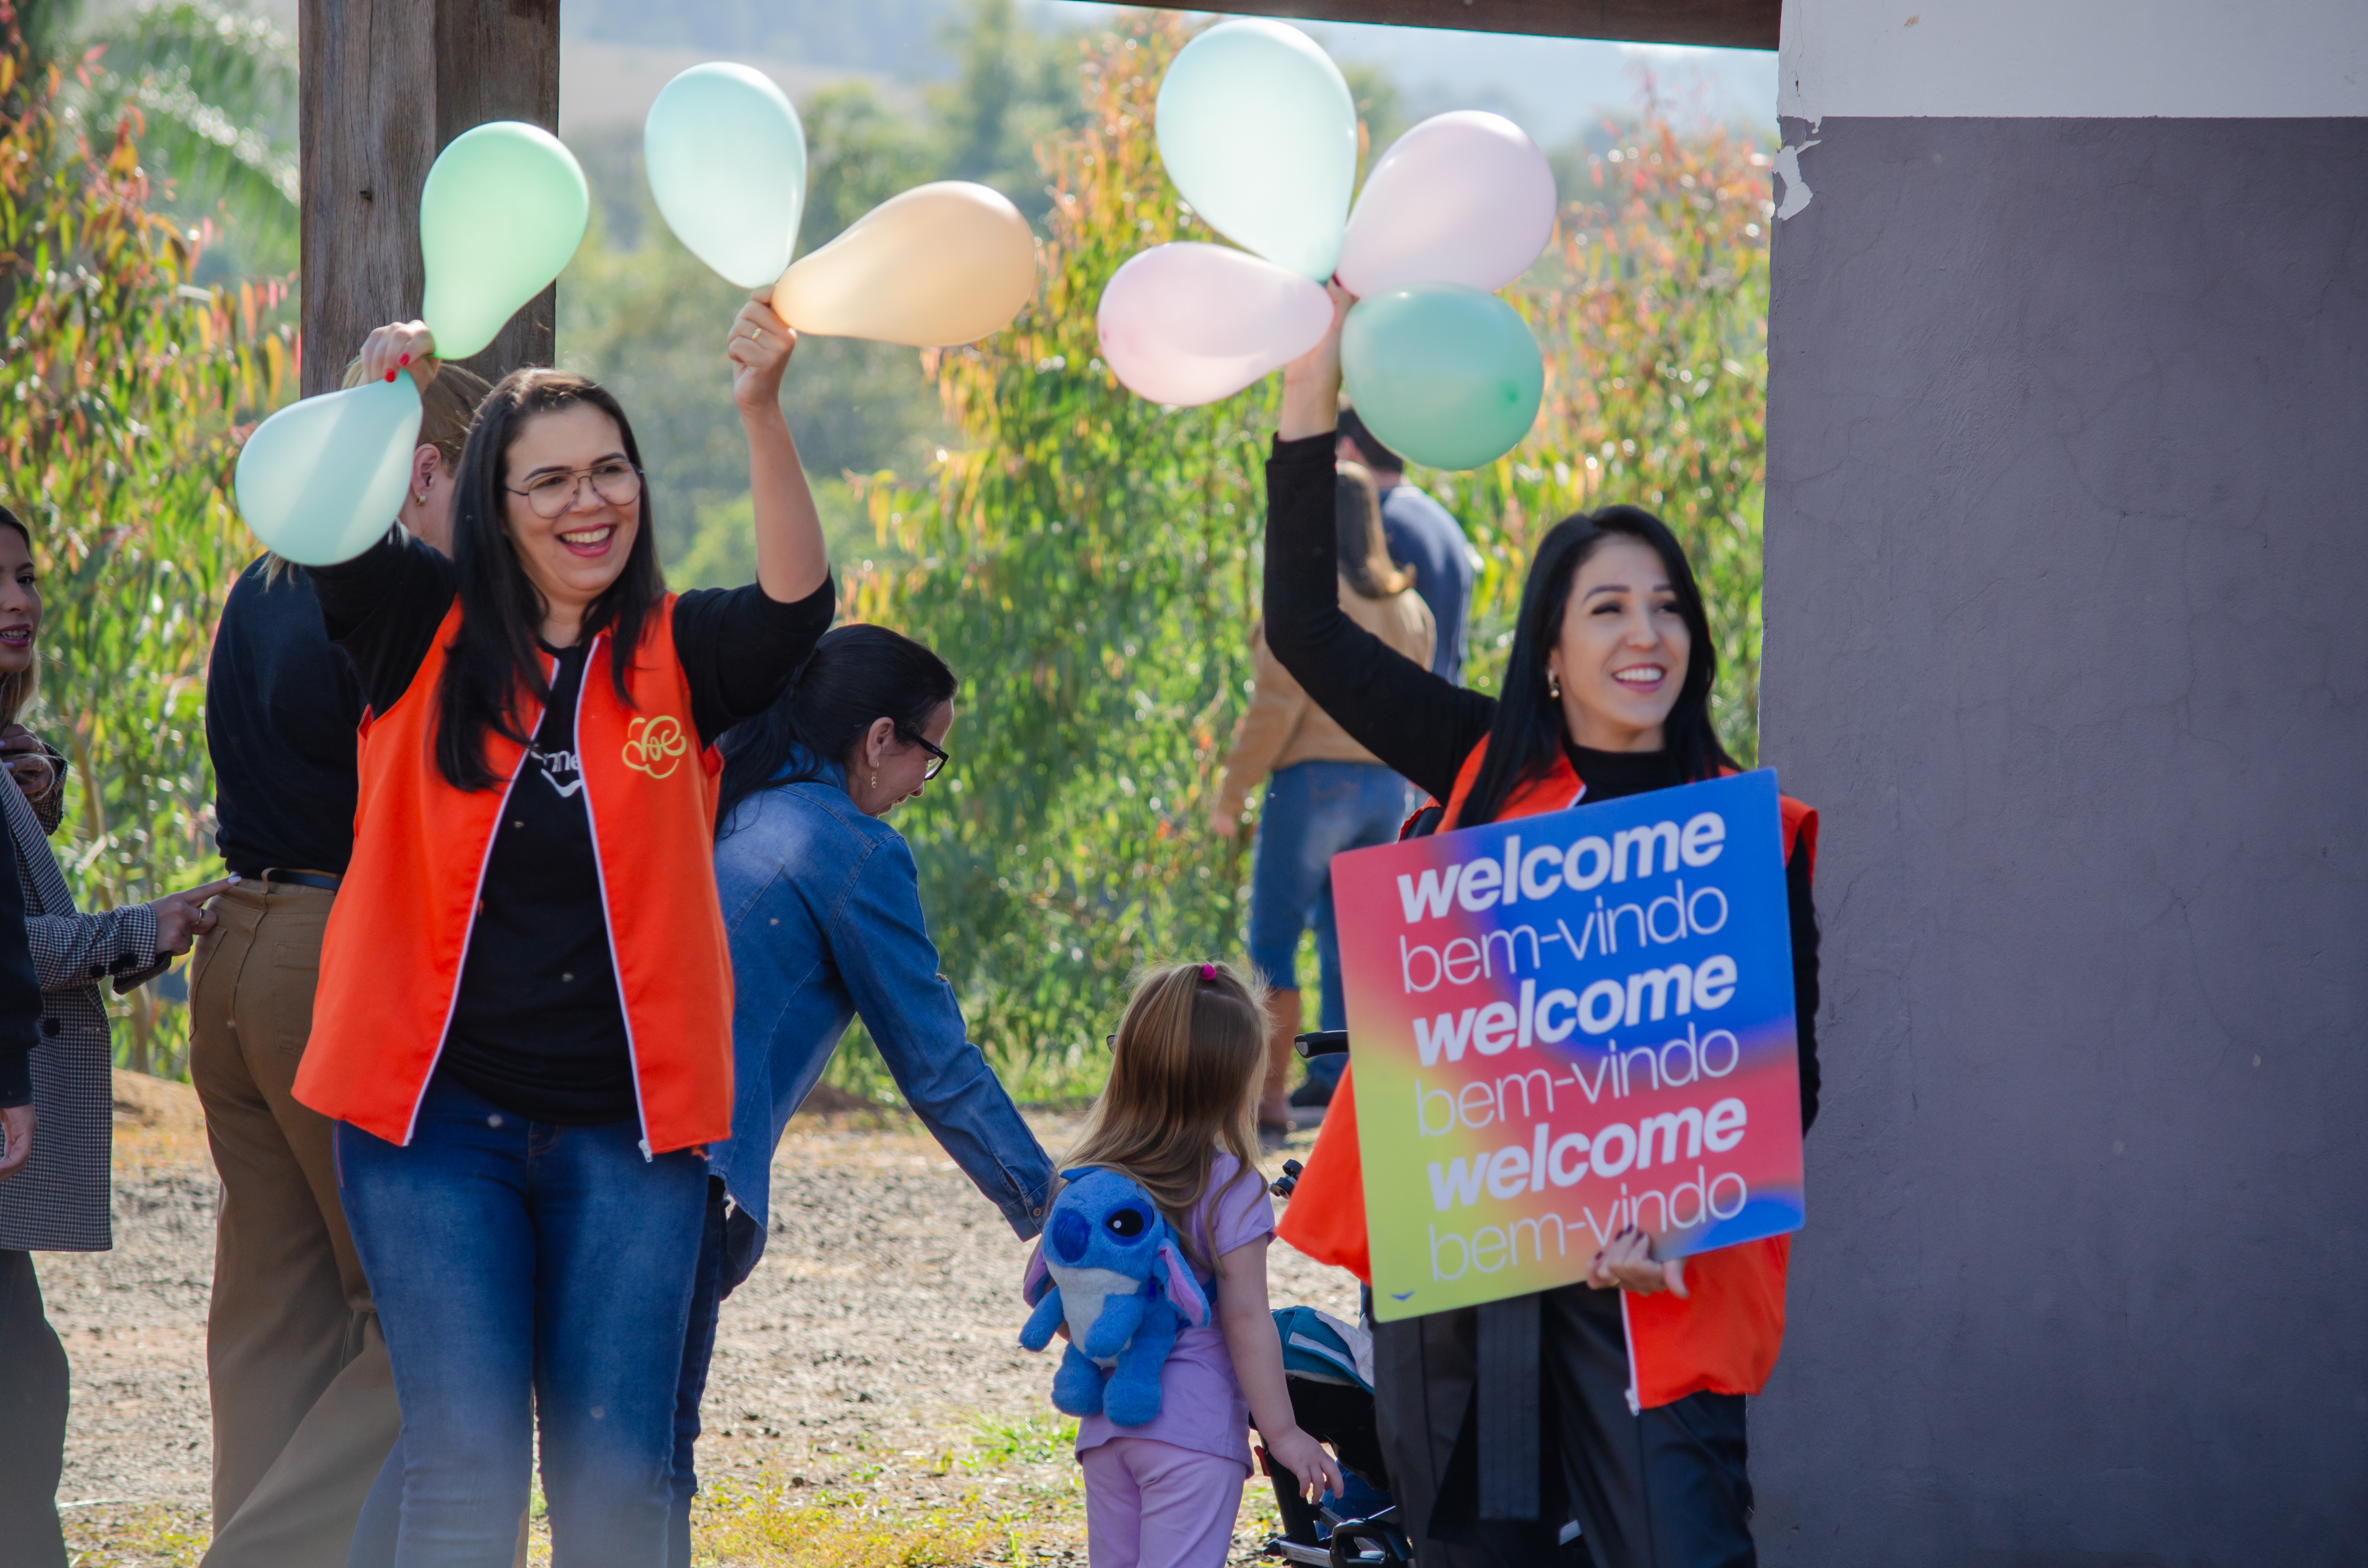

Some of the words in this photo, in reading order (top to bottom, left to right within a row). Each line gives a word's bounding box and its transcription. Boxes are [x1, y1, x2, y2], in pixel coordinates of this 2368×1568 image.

[1398, 812, 1726, 923] welcome
[1400, 880, 1727, 993] bem-vindo
[1414, 956, 1737, 1066] welcome
[1416, 1022, 1739, 1137] bem-vindo
[1428, 1099, 1747, 1211] welcome
[1430, 1165, 1747, 1282] bem-vindo
